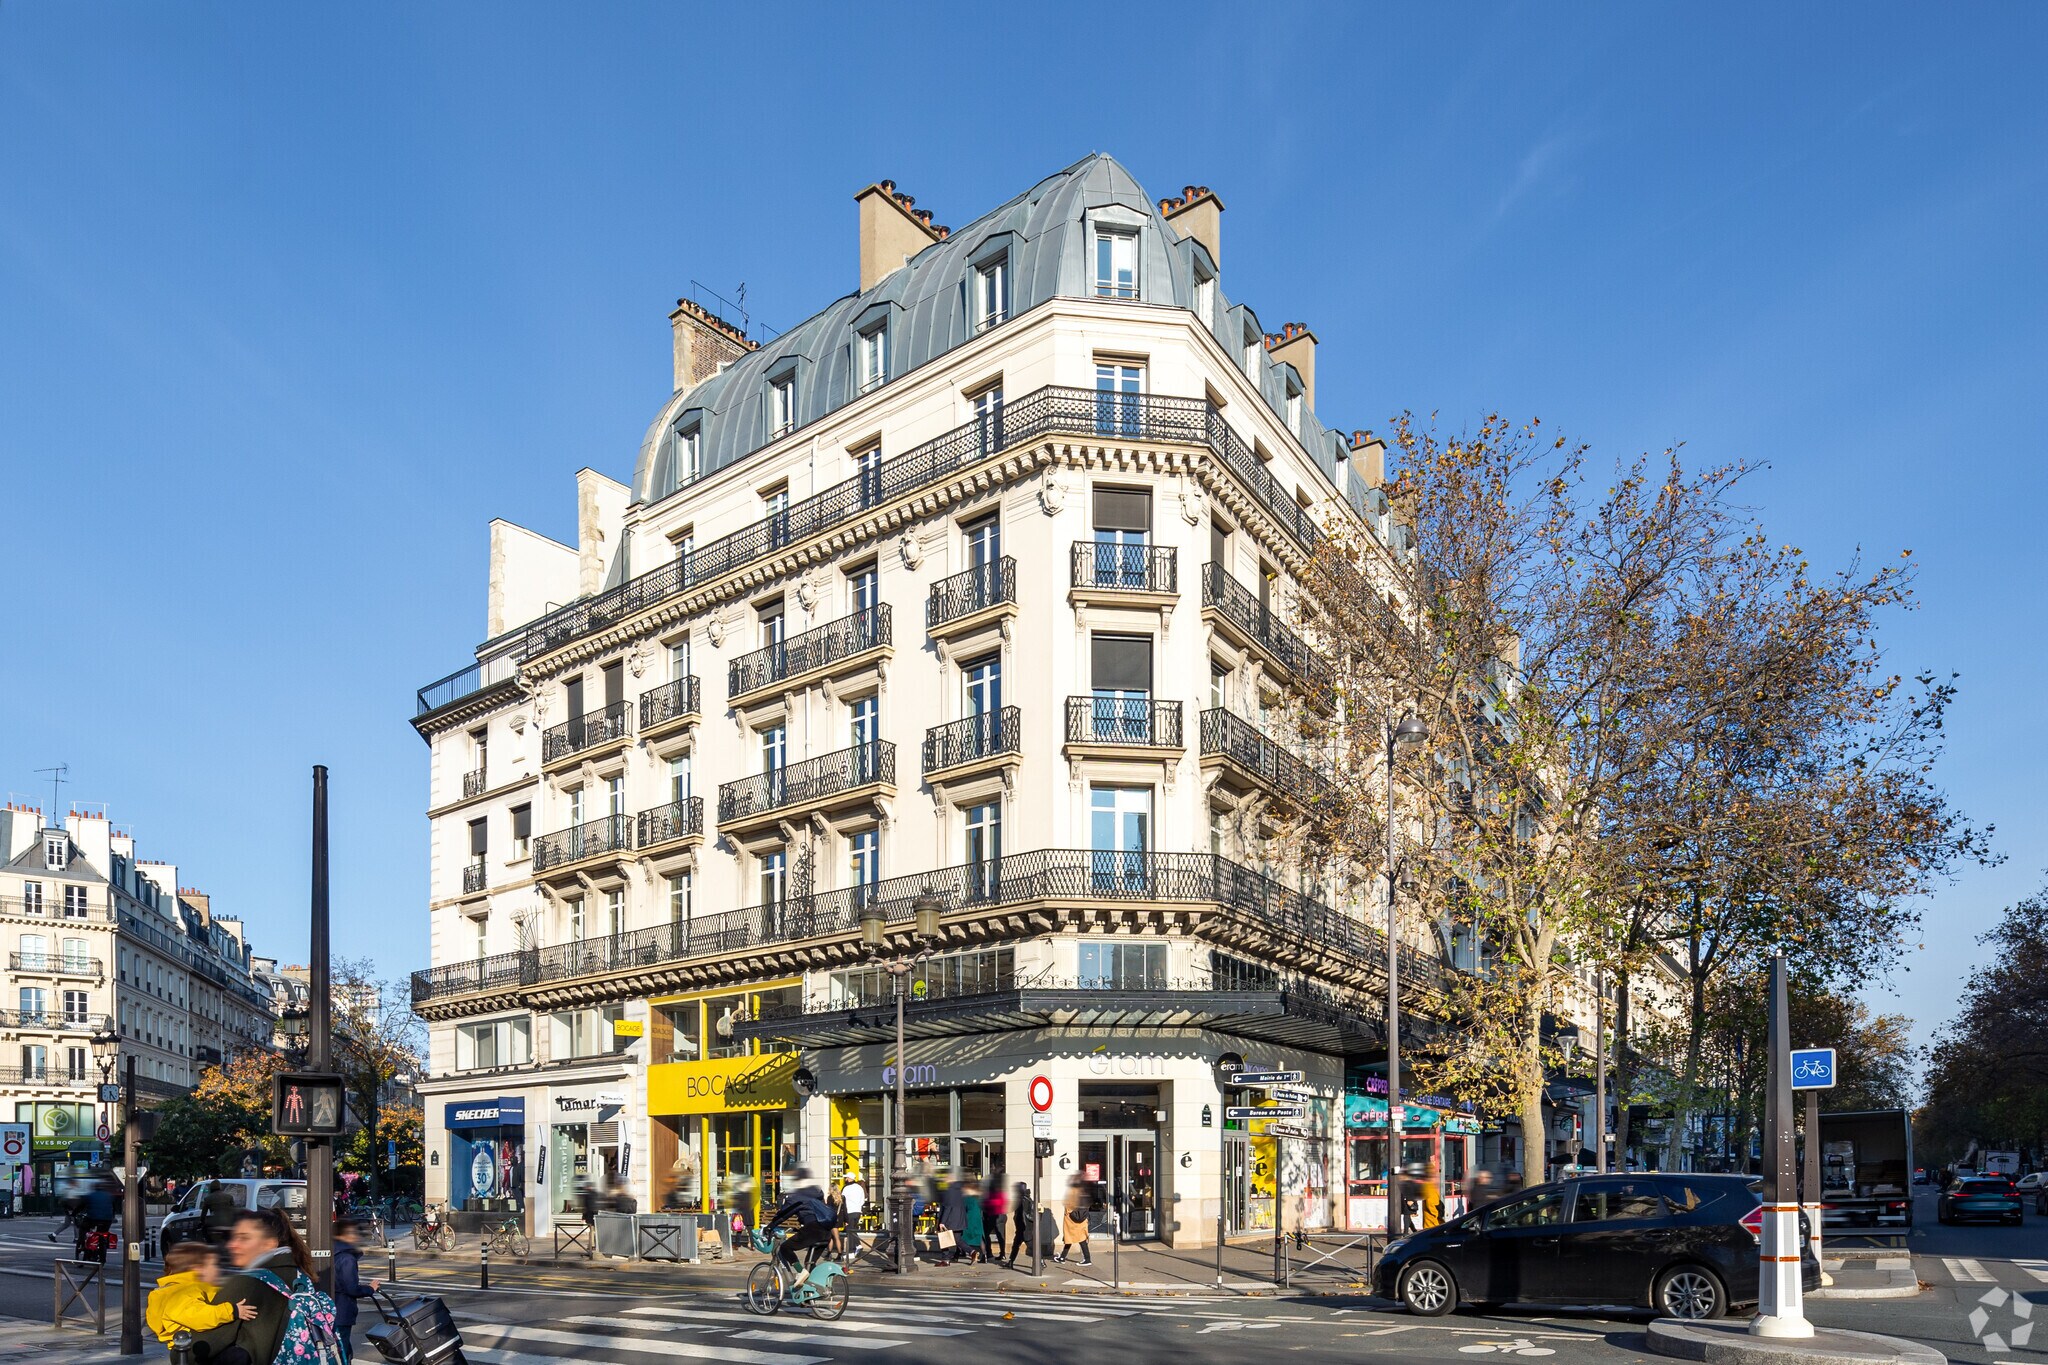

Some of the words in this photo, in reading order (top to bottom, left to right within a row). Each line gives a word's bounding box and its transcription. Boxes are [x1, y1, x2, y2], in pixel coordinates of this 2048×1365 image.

[616, 1024, 640, 1032] BOCAGE
[882, 1057, 936, 1085] éam
[1220, 1061, 1244, 1071] éram
[687, 1073, 757, 1098] BOCAGE
[454, 1107, 499, 1121] SKECHER
[1059, 1153, 1071, 1170] é
[1180, 1152, 1193, 1168] é
